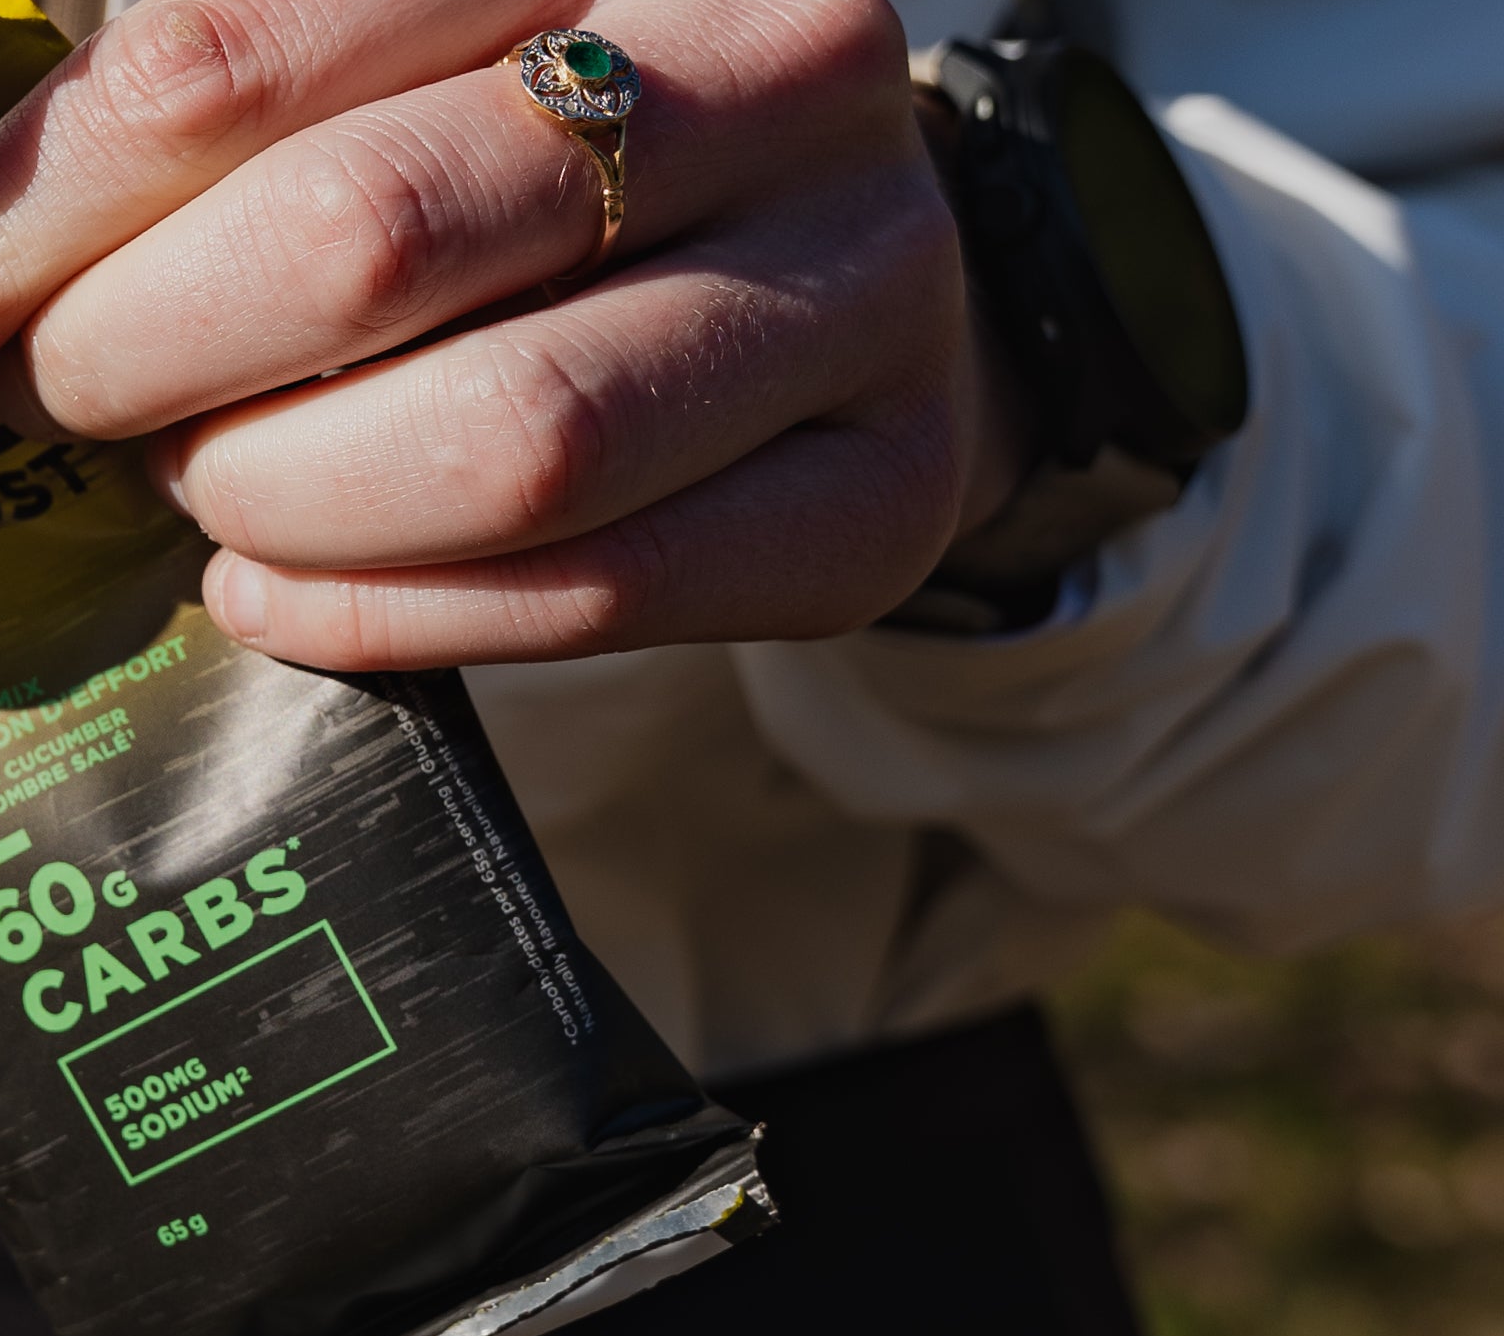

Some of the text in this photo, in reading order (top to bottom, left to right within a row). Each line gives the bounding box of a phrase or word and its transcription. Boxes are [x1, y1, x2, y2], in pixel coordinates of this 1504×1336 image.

[39, 635, 187, 724] D'EFFORT
[3, 707, 129, 780] CUCUMBER
[392, 704, 436, 774] Glucides
[438, 786, 477, 848] serving
[439, 744, 508, 861] Naturellement
[472, 848, 497, 884] 65g
[491, 886, 515, 916] per
[506, 873, 557, 951] flavoured
[103, 1058, 207, 1121] 500MG
